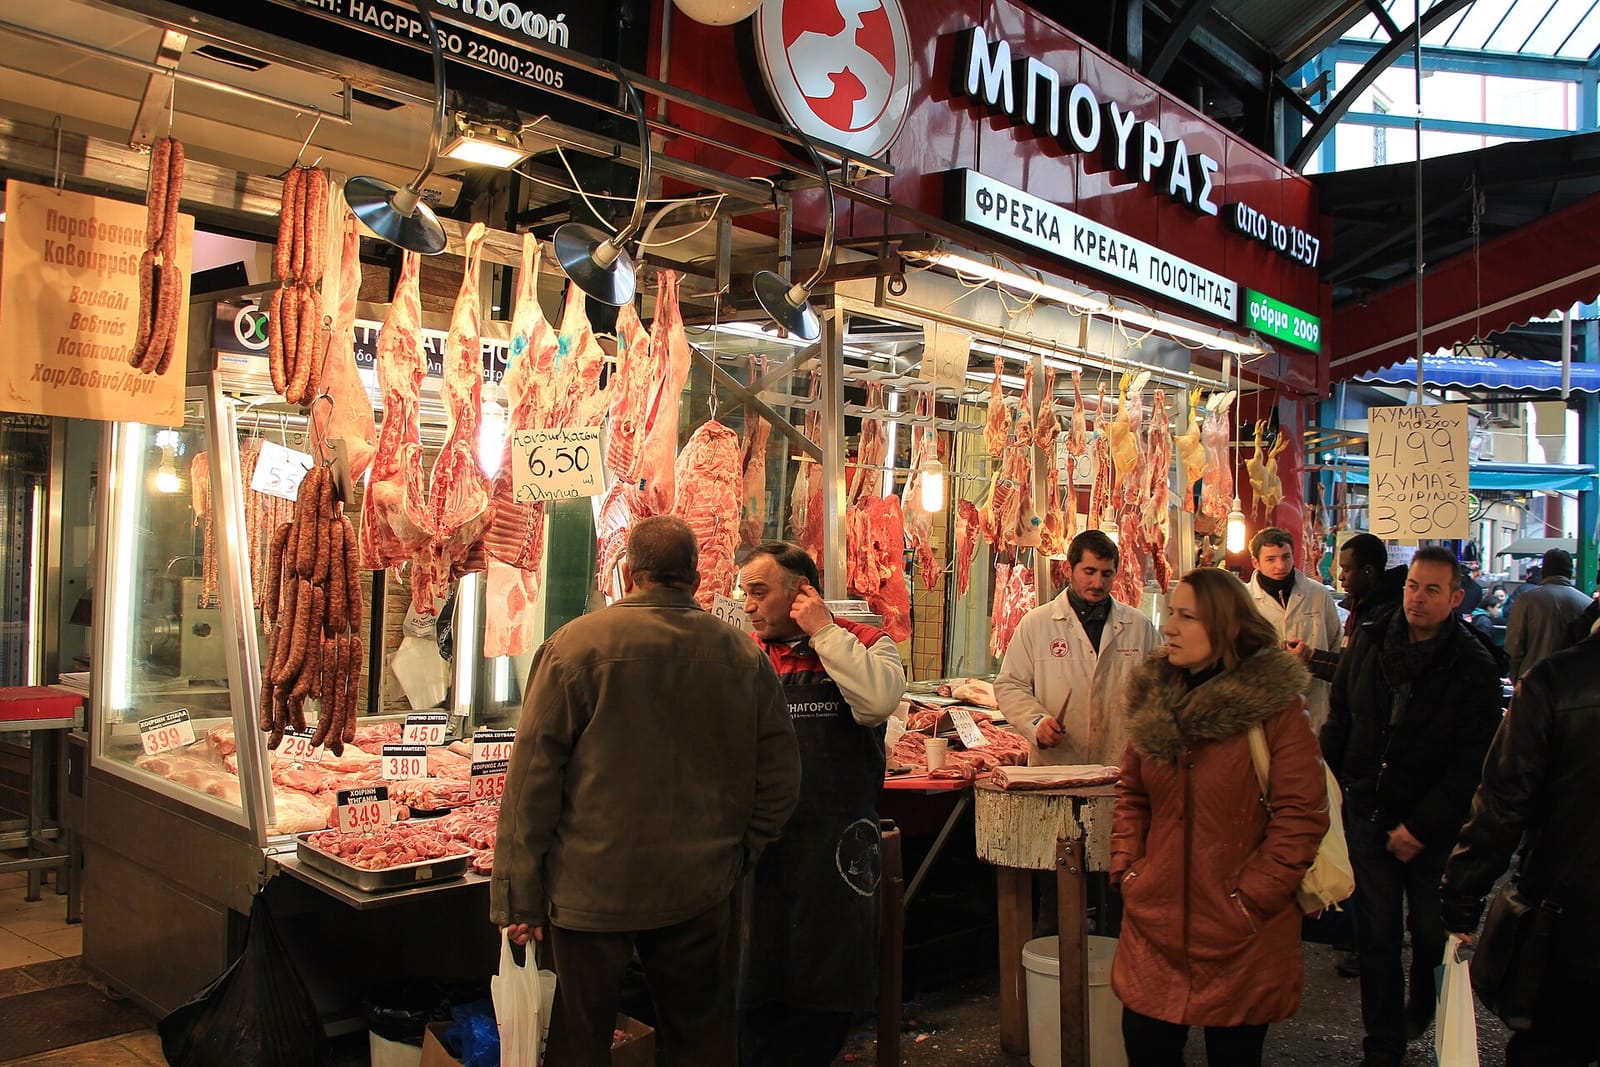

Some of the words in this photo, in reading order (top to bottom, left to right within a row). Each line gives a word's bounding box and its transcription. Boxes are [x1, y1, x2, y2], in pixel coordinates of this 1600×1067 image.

[466, 41, 564, 89] 22000:2005
[966, 25, 1220, 218] ΜΠΟΥΡΑΣ
[1236, 201, 1267, 240] απο
[1270, 219, 1287, 251] το
[1290, 227, 1320, 268] 1957
[976, 187, 1061, 245] ΦΡΕΣΚΑ
[1073, 225, 1138, 273] ΚΡΕΑΤΑ
[1149, 257, 1232, 311] ΠΟΙΟΤΗΤΑΣ
[1250, 302, 1289, 331] φάρμα
[1293, 316, 1319, 341] 2009
[1372, 407, 1441, 424] ΚΥΜΑΣ
[1398, 420, 1460, 429] ΜΟΣΧΟΥ
[529, 446, 590, 478] 6,50
[1376, 472, 1461, 491] ΚΥΜΑΣ
[1377, 491, 1469, 504] ΧΟΙΡΙΝΟΣ
[410, 726, 439, 742] 450
[481, 743, 512, 760] 440
[390, 758, 420, 775] 380
[475, 776, 505, 797] 335
